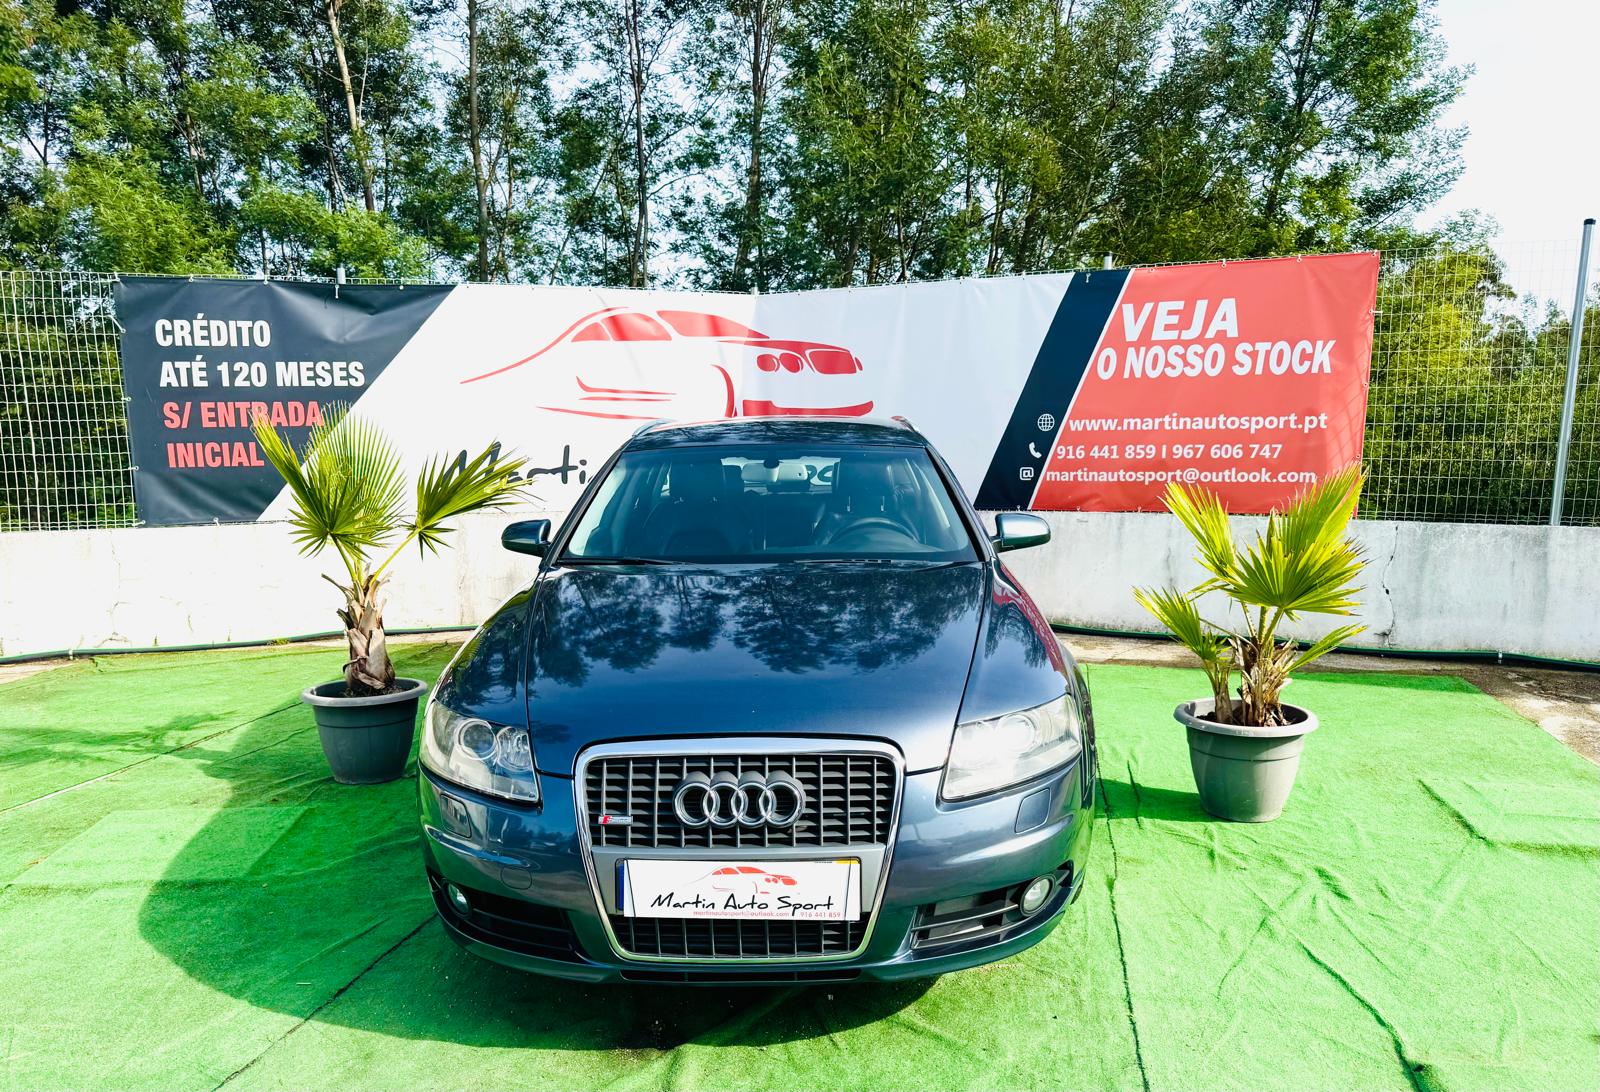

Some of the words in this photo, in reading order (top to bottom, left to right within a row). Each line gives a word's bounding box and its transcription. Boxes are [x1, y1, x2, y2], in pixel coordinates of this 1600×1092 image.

[155, 313, 271, 347] CRÉDITO
[1122, 298, 1239, 342] VEJA
[159, 355, 208, 387] ATÉ
[217, 361, 268, 387] 120
[275, 361, 366, 387] MESES
[1096, 347, 1117, 380] O
[1123, 343, 1226, 379] NOSSO
[1231, 339, 1336, 376] STOCK
[163, 401, 192, 429] S/
[201, 401, 325, 428] ENTRADA
[1069, 412, 1328, 434] www.martinautosport.pt
[167, 442, 264, 468] INICIAL
[1056, 444, 1085, 460] 916
[1089, 444, 1118, 459] 441
[1124, 444, 1156, 459] 859
[1172, 444, 1203, 459] 967
[1210, 444, 1244, 459] 606
[1248, 443, 1282, 458] 747
[1046, 467, 1317, 486] martinautosport@outlook.com
[650, 892, 716, 909] Martin
[723, 892, 769, 910] Auto
[777, 895, 834, 917] Sport
